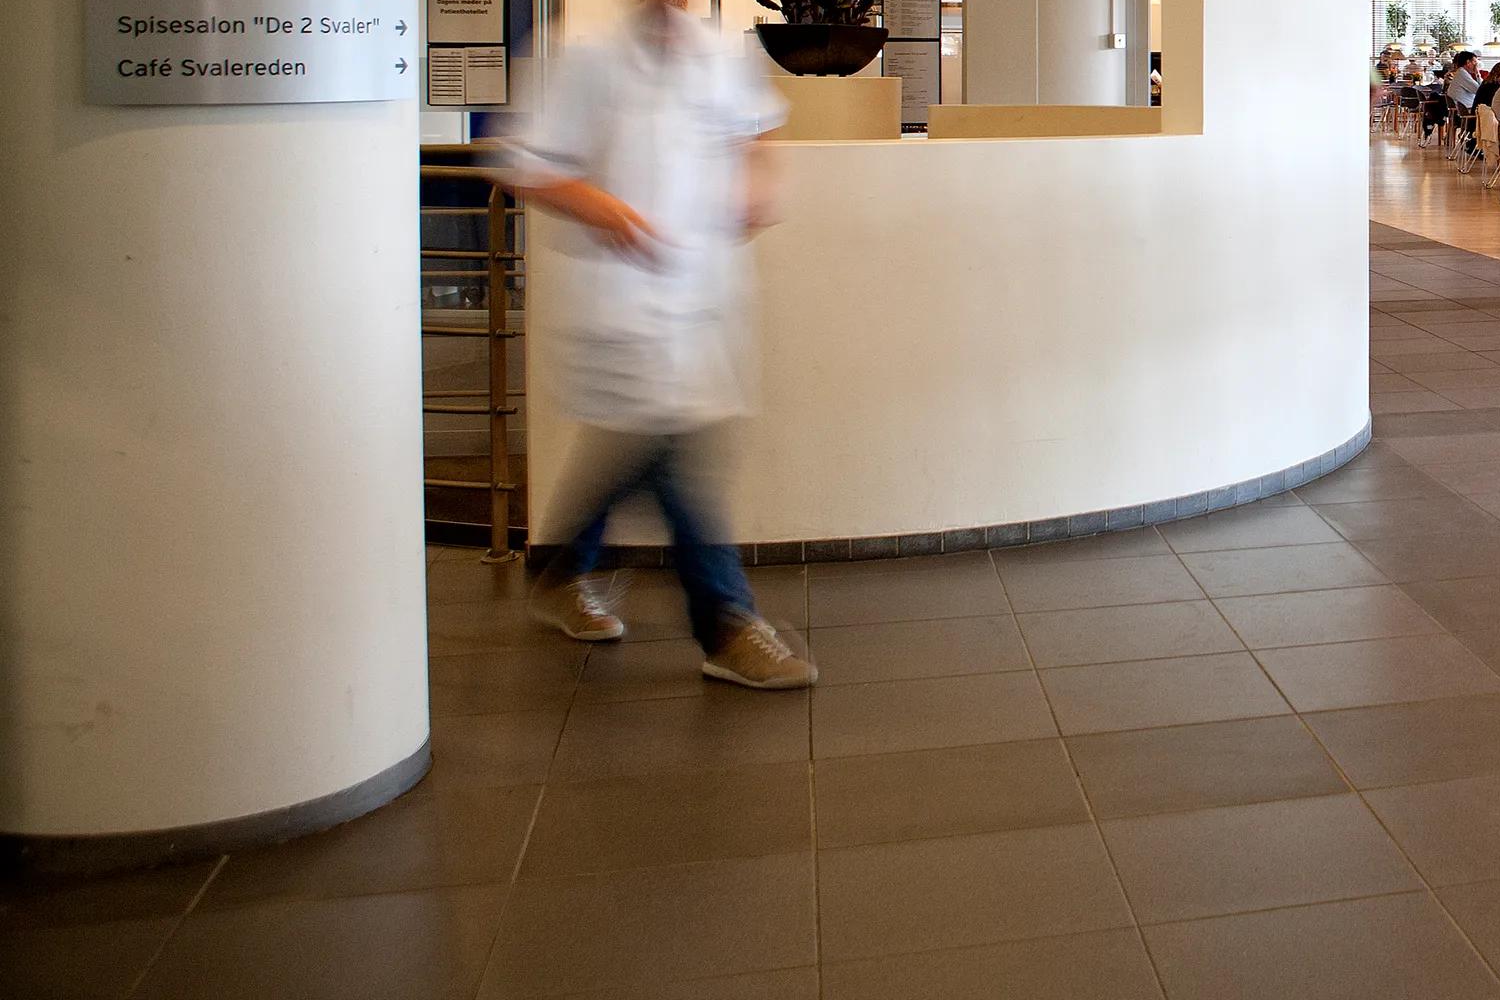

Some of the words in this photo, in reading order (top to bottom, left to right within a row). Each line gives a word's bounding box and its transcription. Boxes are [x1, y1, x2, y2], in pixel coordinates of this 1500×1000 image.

[118, 16, 245, 37] Spisesalon
[254, 16, 293, 34] "De
[300, 17, 313, 34] 2
[320, 17, 380, 34] Svaler"
[118, 58, 172, 77] Café
[181, 59, 306, 77] Svalereden
